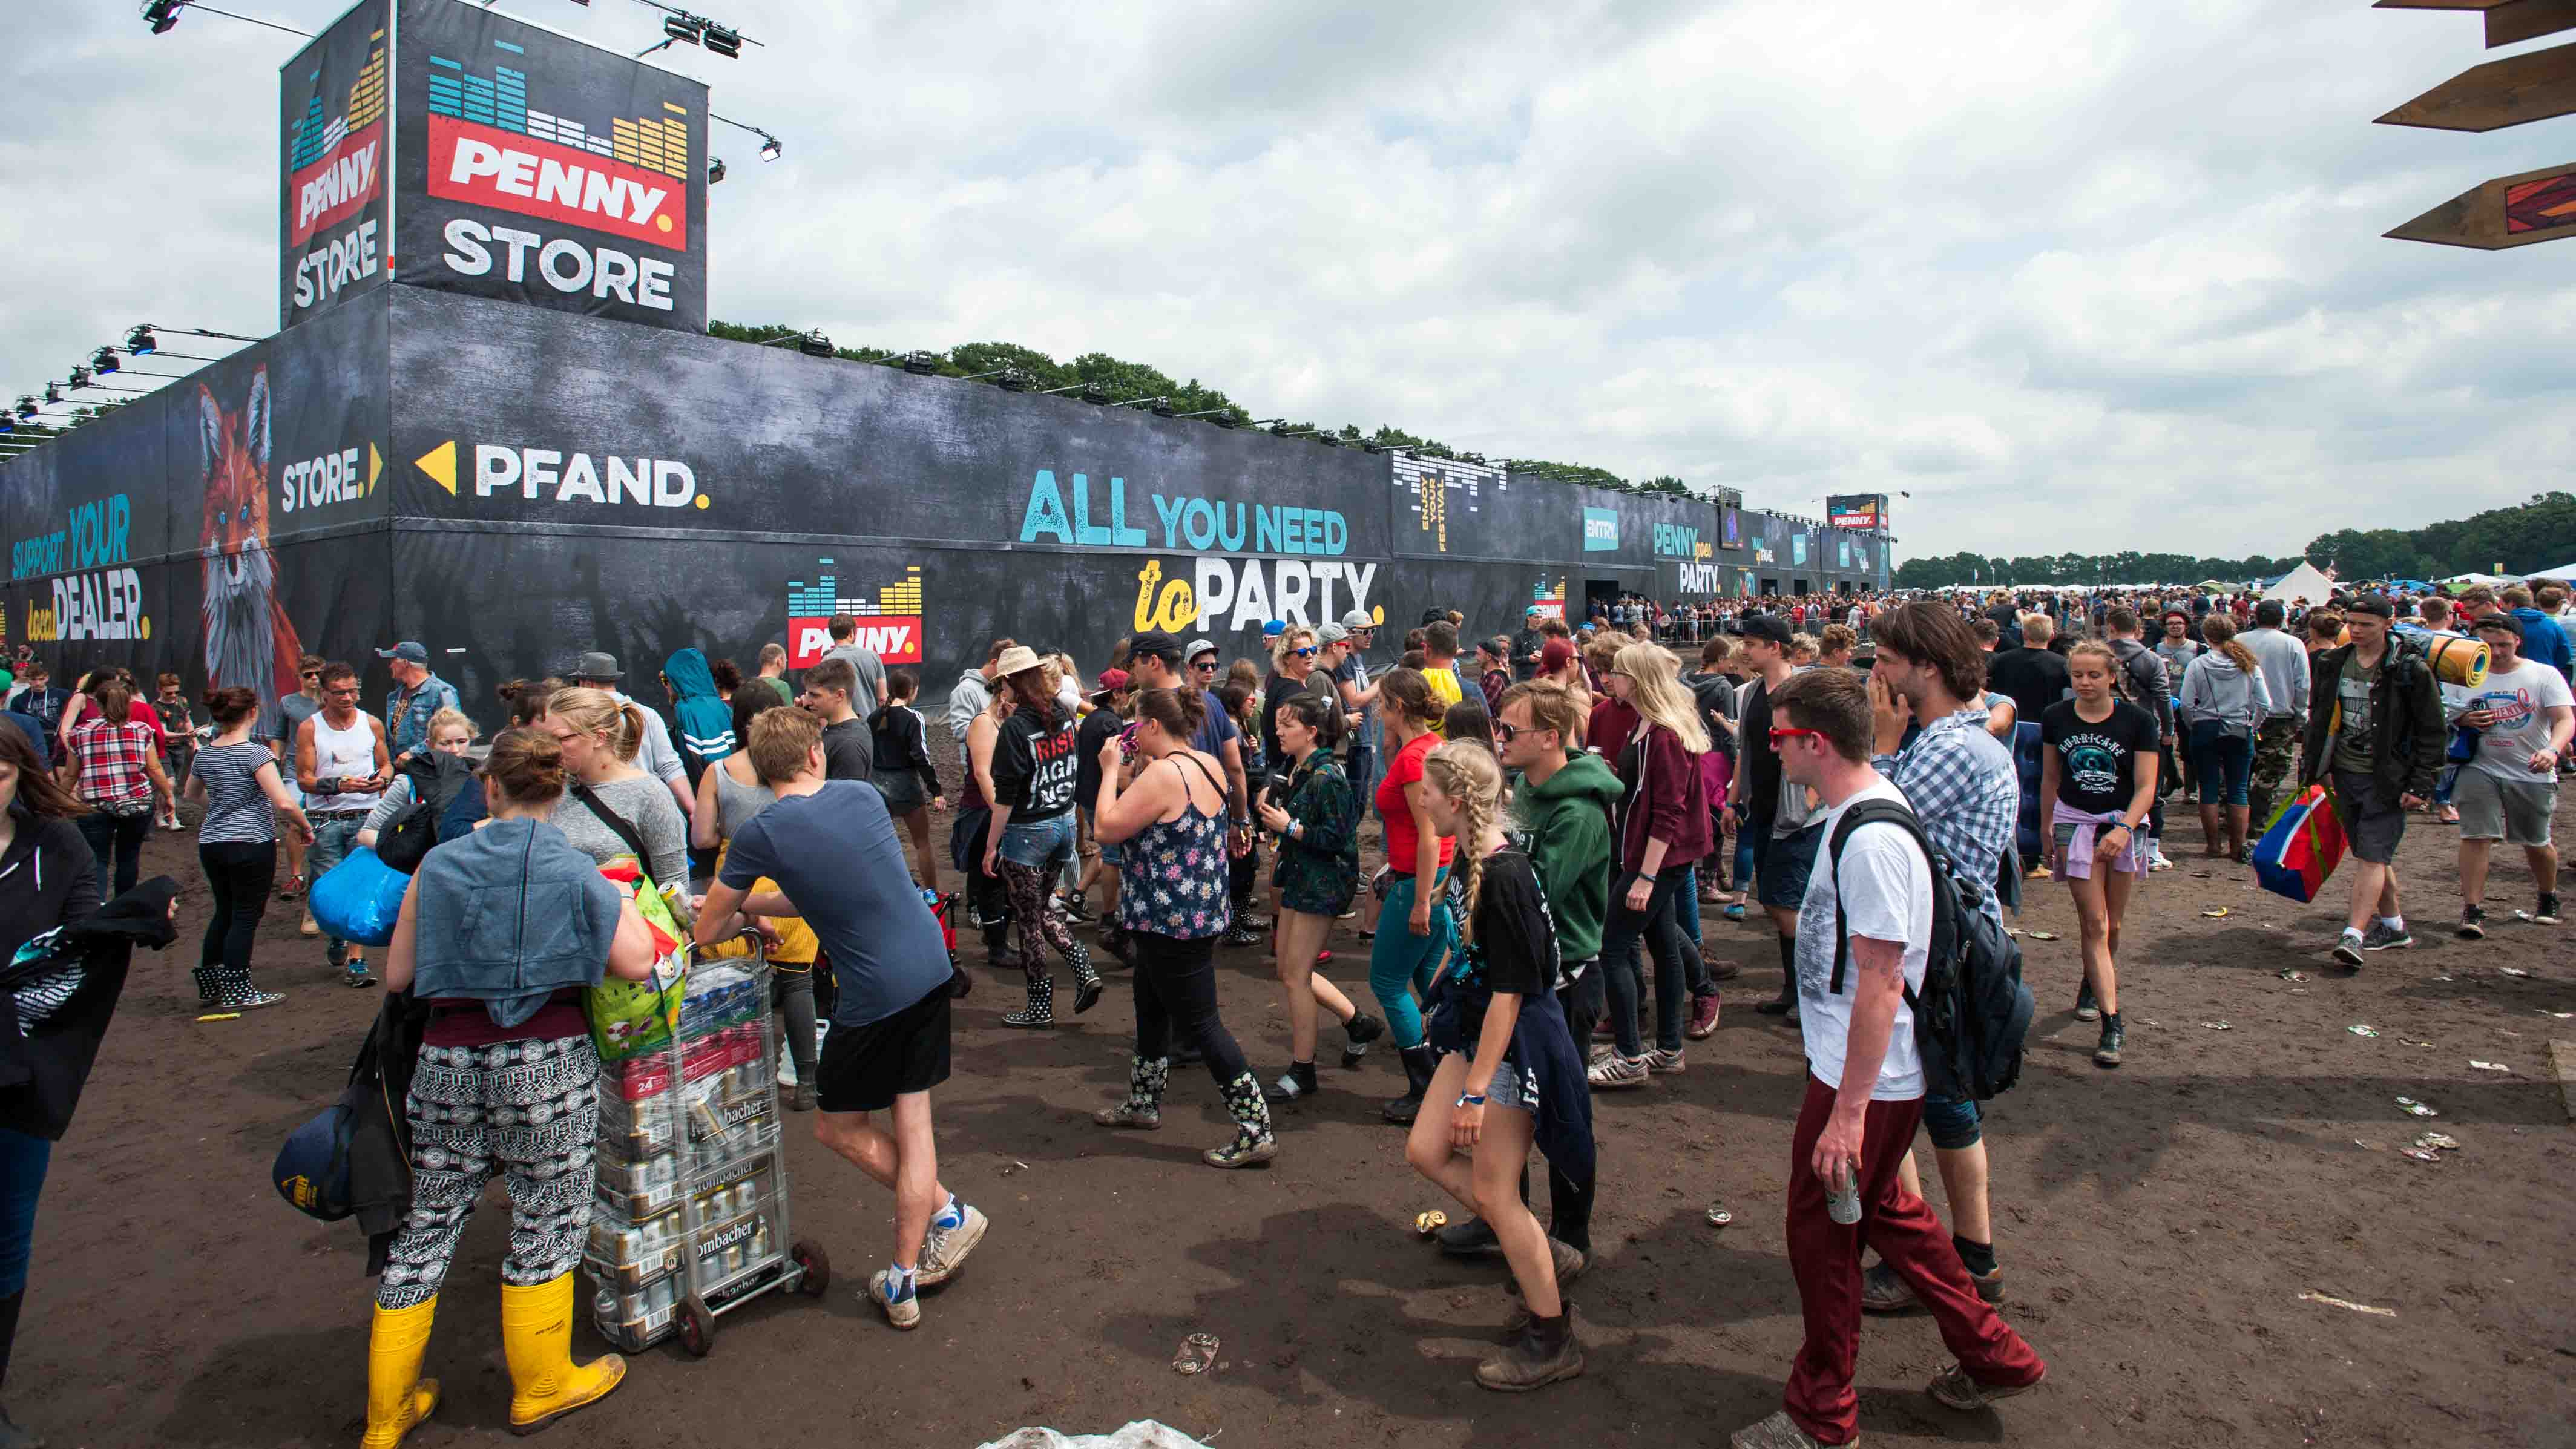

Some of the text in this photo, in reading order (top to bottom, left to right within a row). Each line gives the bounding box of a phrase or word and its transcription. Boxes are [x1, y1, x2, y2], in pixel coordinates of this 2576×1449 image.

[294, 219, 378, 308] STORE
[443, 218, 674, 311] STORE
[281, 447, 364, 513] STORE.
[476, 445, 711, 510] PFAND.
[1020, 470, 1347, 556] ALL YOU NEED
[12, 493, 130, 580] SUPPORT YOUR
[1438, 479, 1447, 552] FESTIVAL
[1654, 522, 1700, 557] PENNY
[53, 567, 151, 641] DEALER.
[1134, 559, 1201, 634] to
[1680, 562, 1721, 593] PARTY.
[637, 1078, 653, 1094] 24
[697, 1220, 753, 1257] ombacher
